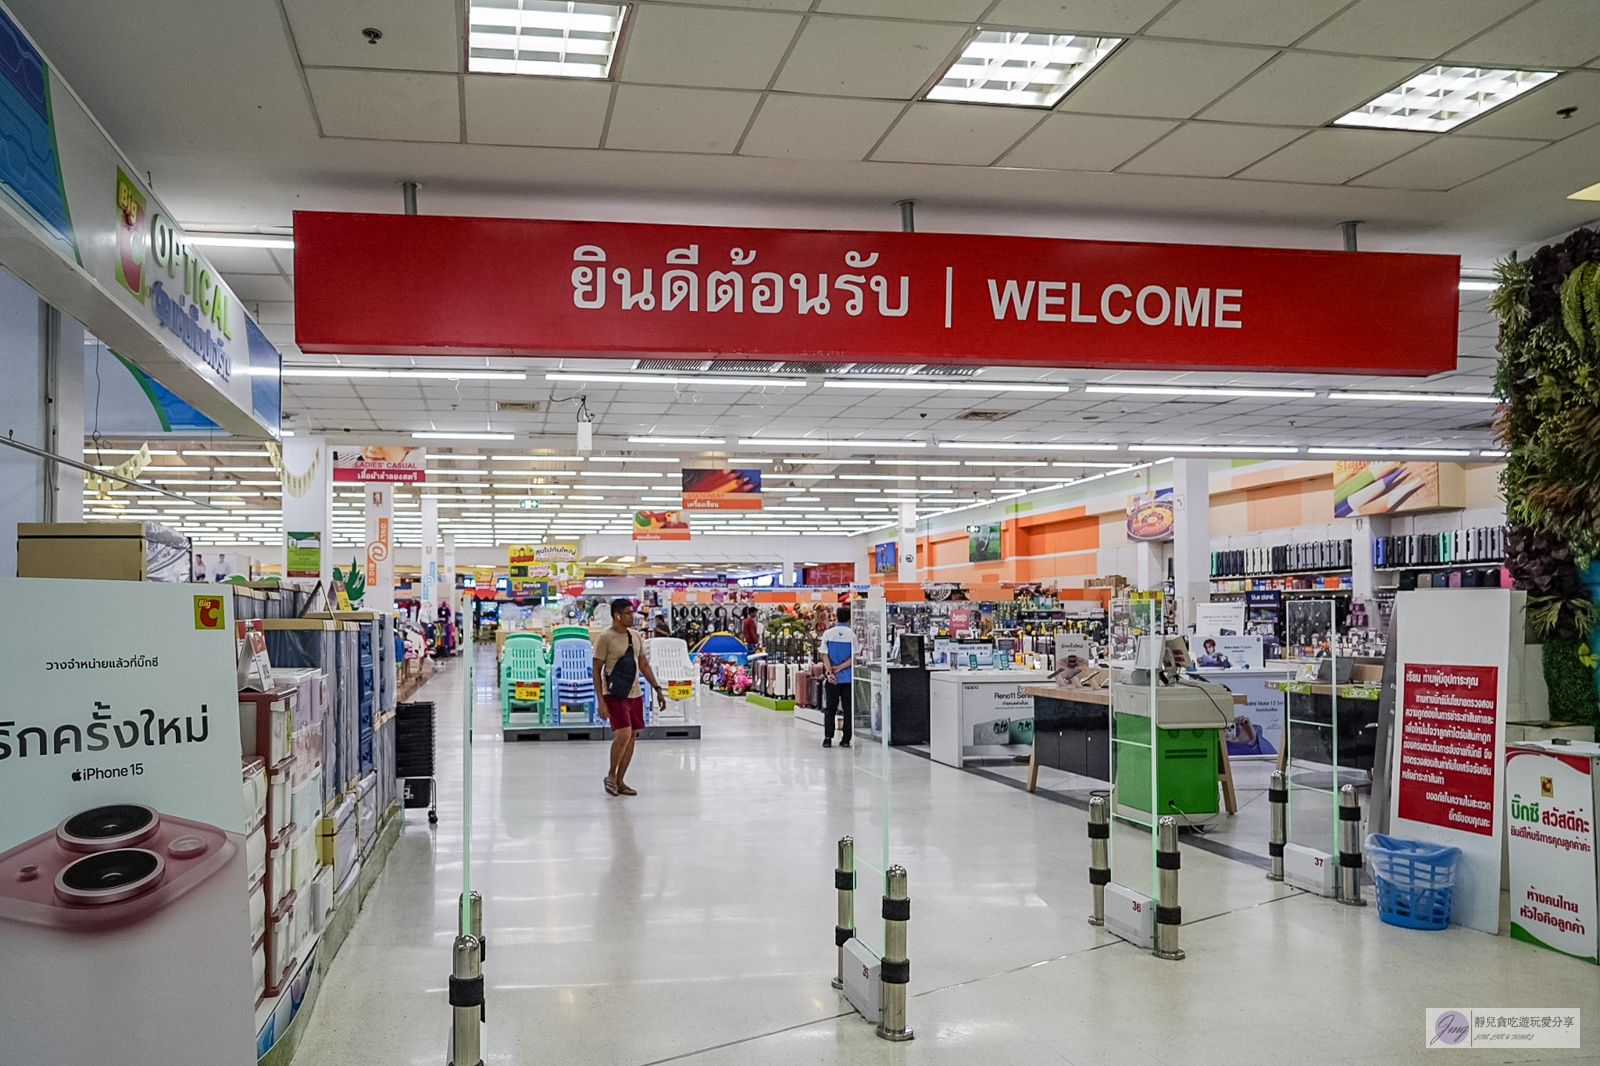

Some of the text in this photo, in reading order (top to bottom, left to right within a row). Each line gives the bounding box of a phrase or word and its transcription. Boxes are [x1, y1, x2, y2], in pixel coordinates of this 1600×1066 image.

[119, 181, 138, 224] Big
[152, 213, 232, 340] OPTICAL
[571, 244, 909, 317] ยินดีต้อนรับ
[987, 278, 1243, 329] WELCOME
[368, 563, 376, 576] BIG
[198, 599, 211, 609] Big
[46, 654, 159, 671] วางจำหน่ายแล้วที่บิ๊กซี
[83, 763, 144, 781] iPhone 15
[1511, 794, 1539, 823] บิ๊กซี
[1315, 856, 1324, 867] 37
[1132, 900, 1142, 913] 36
[1526, 886, 1579, 913] ห้างคนไทย
[1520, 905, 1585, 935] หัวใจคือลูกค้า
